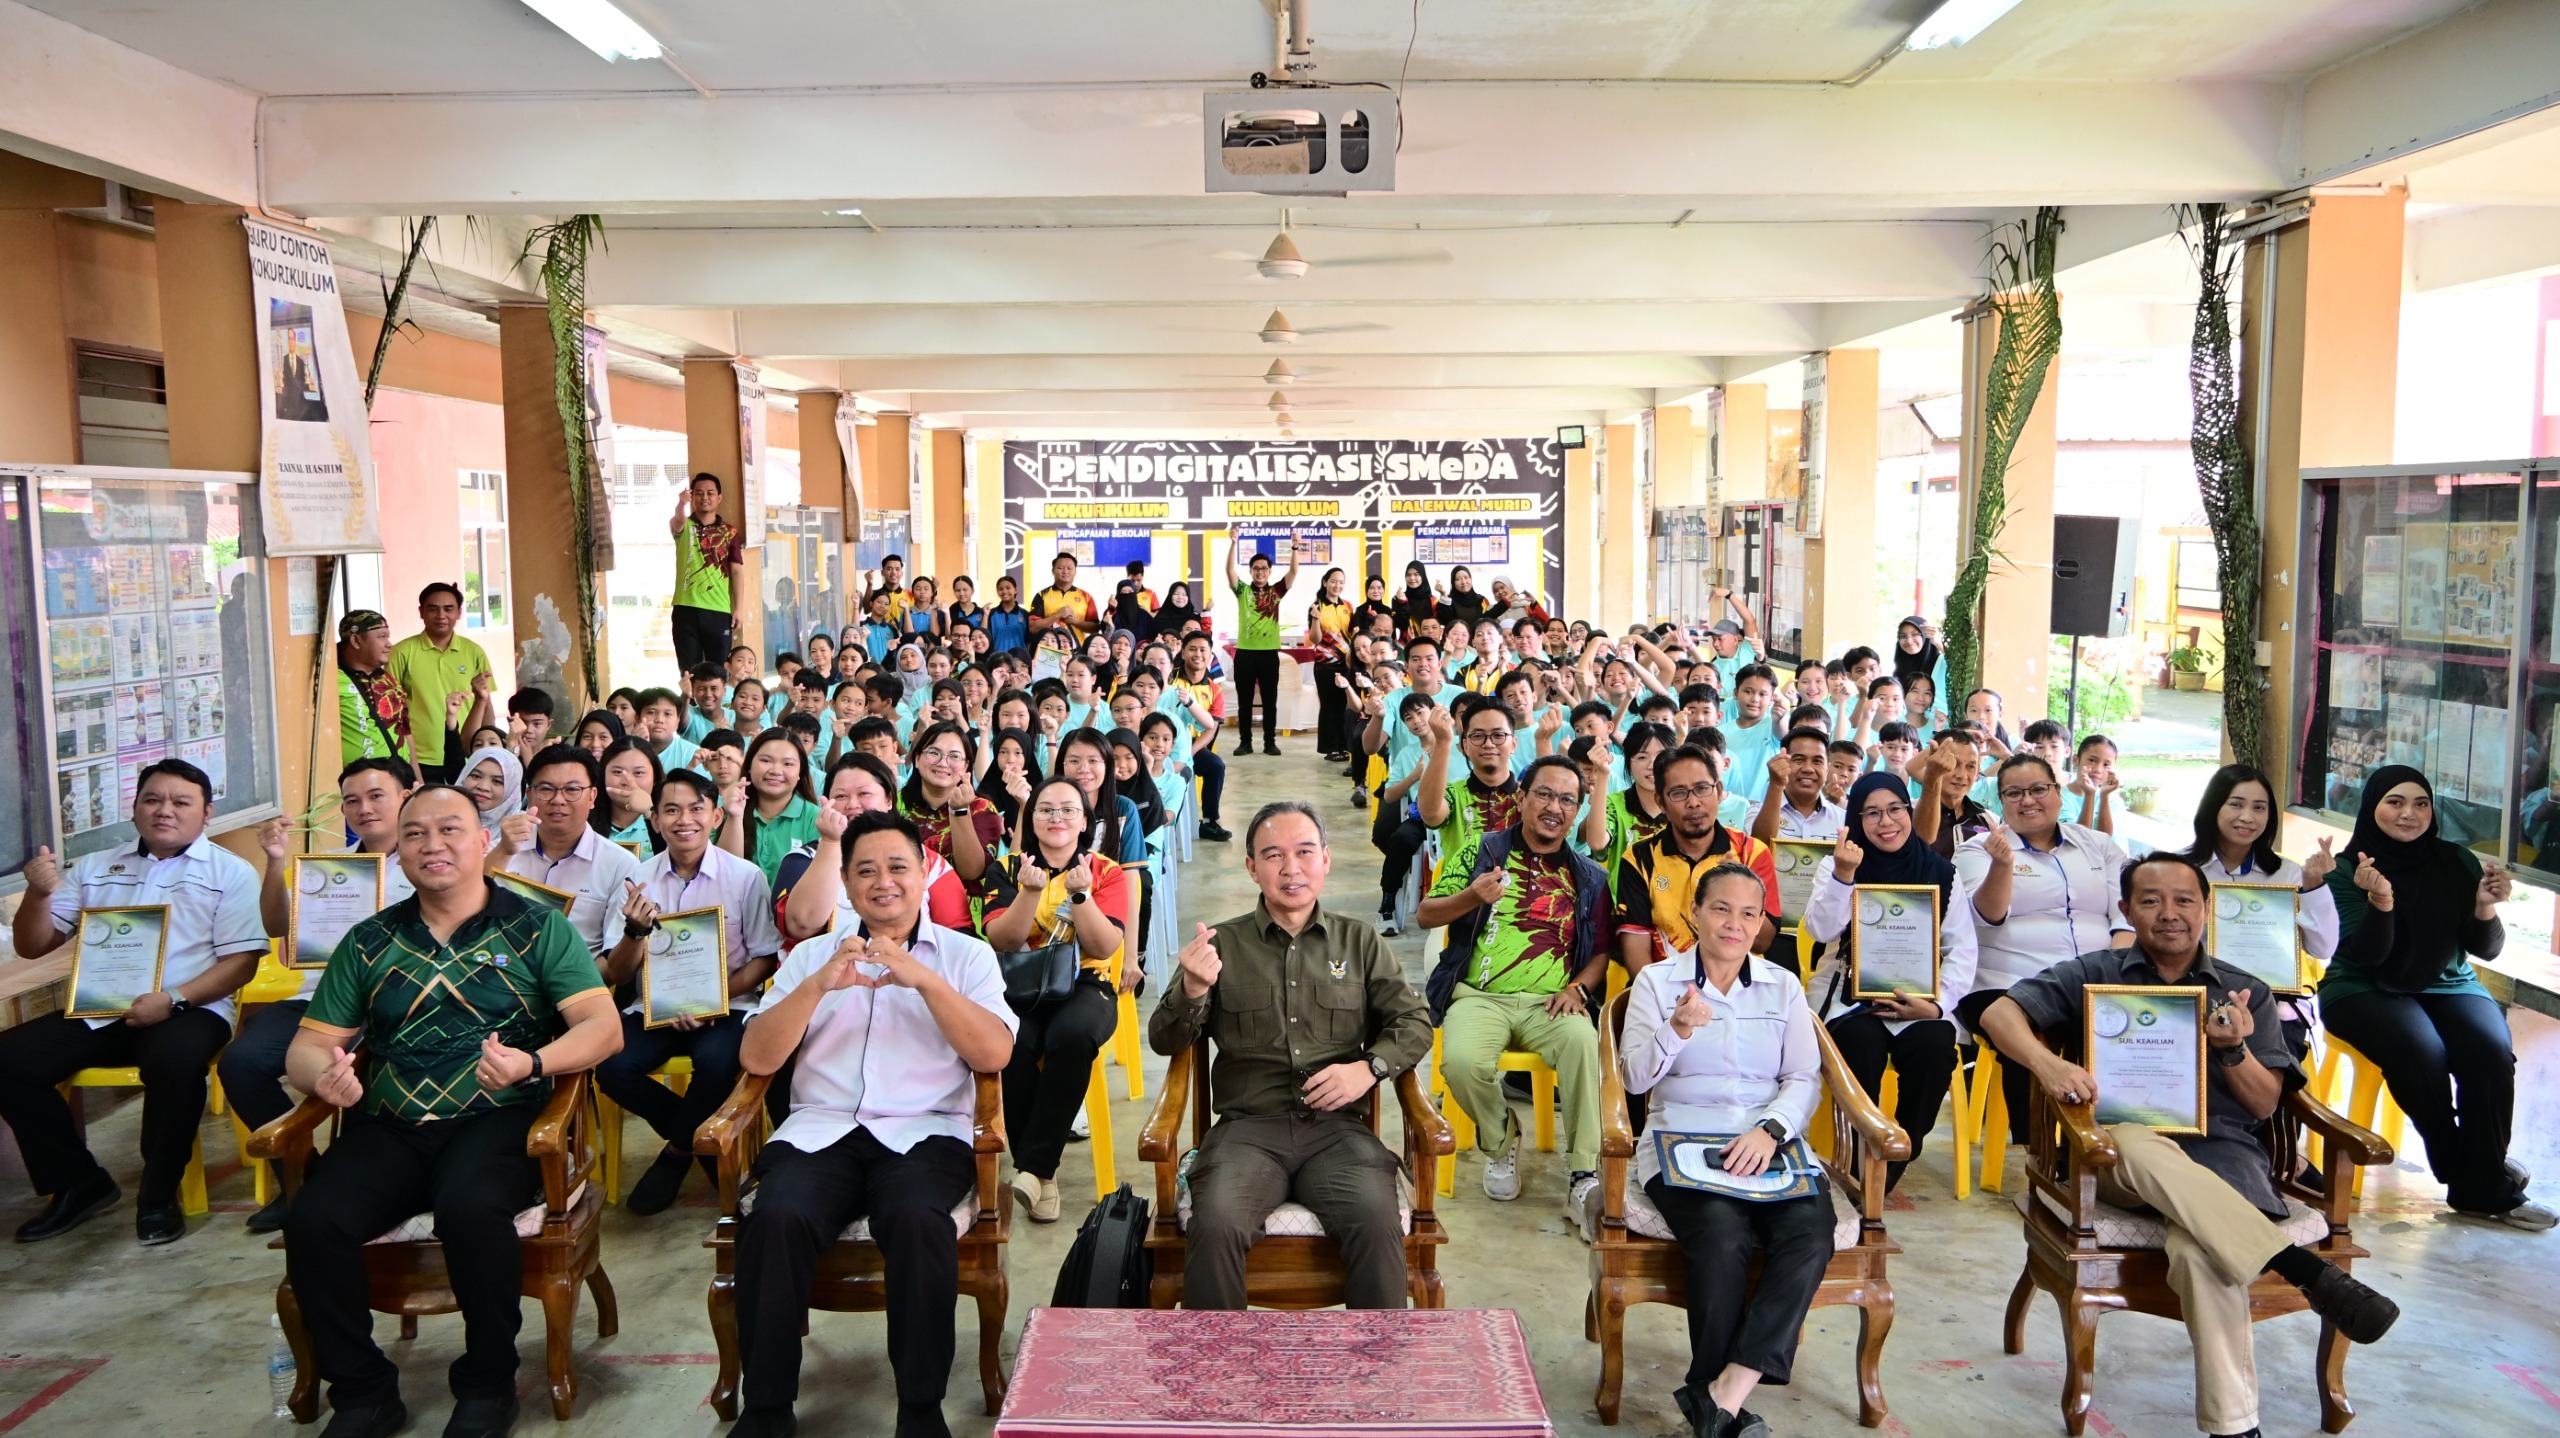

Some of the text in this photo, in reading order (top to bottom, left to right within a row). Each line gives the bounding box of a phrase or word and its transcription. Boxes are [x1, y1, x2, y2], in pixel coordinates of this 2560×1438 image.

[280, 235, 329, 265] CONTOH
[252, 256, 335, 294] KOKURIKULUM
[278, 463, 343, 474] ZAINAL HASHIM
[1049, 453, 1518, 482] PENDIGITALISASI SMeDA
[1044, 502, 1169, 519] KOKURIKULUM
[1228, 501, 1339, 516] KURIKULUM
[1391, 499, 1532, 512] HAL EHWAL MURID
[1057, 528, 1150, 538] PENCAPAIAN SEKOLAH
[1239, 527, 1290, 536] PENCAPAIAN
[1417, 526, 1507, 536] PENCAPAIAN ASRAMA
[2118, 1037, 2174, 1046] SIJIL KEAHLIAN
